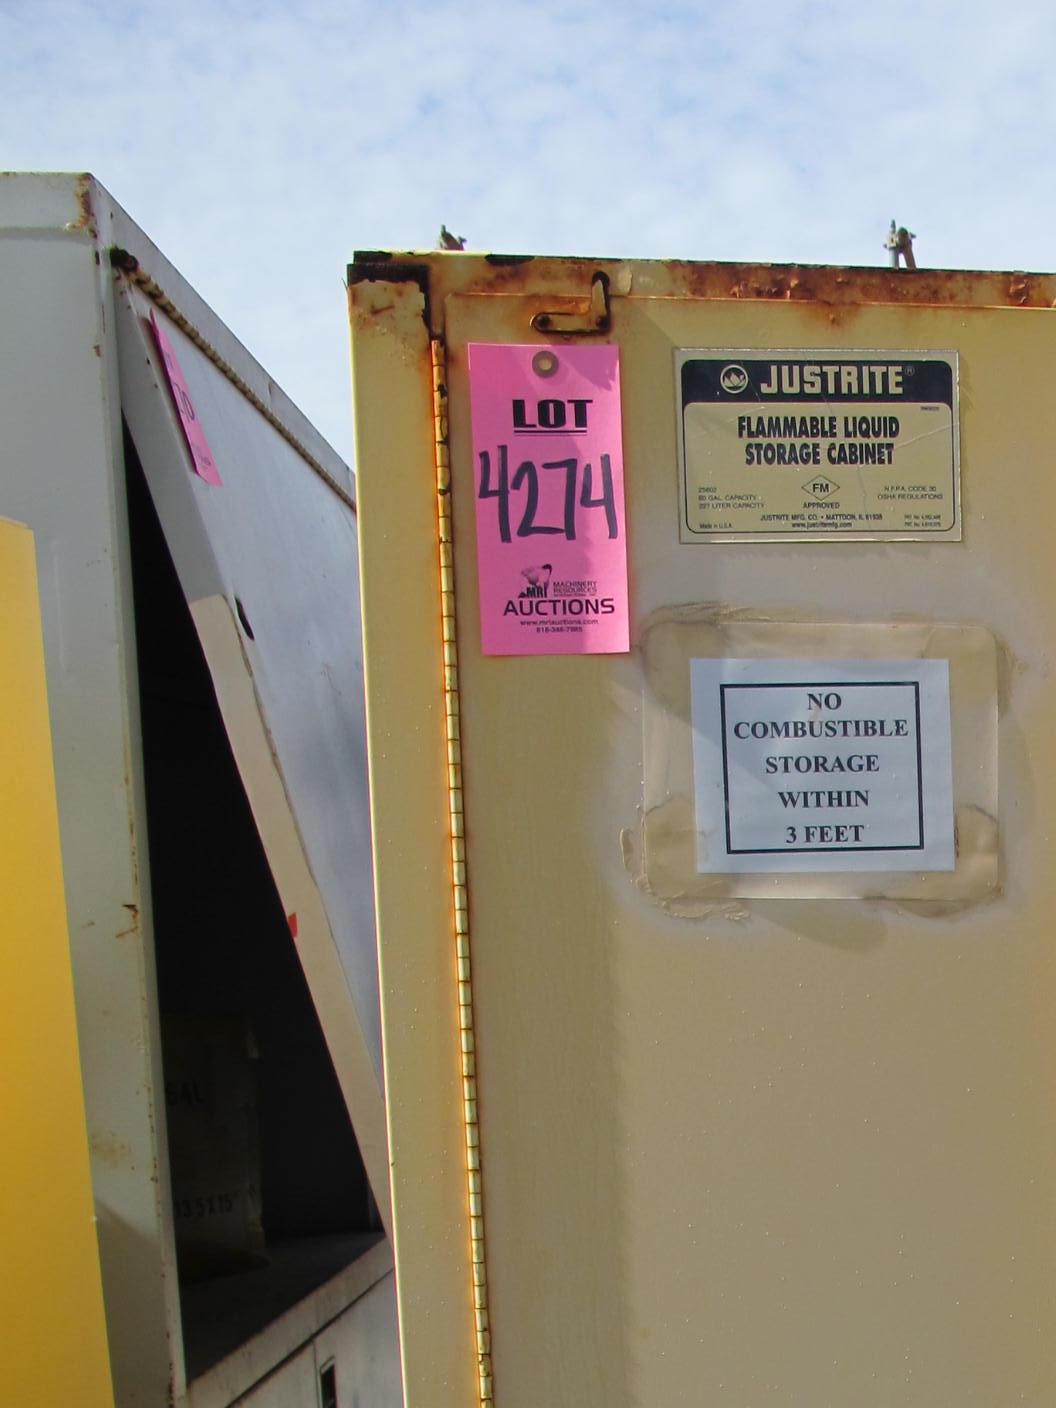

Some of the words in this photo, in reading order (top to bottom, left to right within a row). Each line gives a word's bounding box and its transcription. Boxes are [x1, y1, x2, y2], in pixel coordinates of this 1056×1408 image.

[760, 365, 904, 395] JUSTRITE
[512, 399, 593, 429] LOT
[738, 415, 837, 439] FLAMMABLE
[843, 415, 900, 440] LIQUID
[745, 442, 821, 465] STORAGE
[827, 442, 894, 465] CABINET
[478, 445, 618, 543] 4274
[812, 483, 829, 493] FM
[526, 583, 548, 598] MRI
[503, 598, 615, 616] AUCTIONS
[807, 692, 842, 711] NO
[733, 719, 908, 740] COMBUSTIBLE
[765, 754, 880, 775] STORAGE
[778, 790, 870, 809] WITHIN
[786, 826, 797, 844] 3
[804, 825, 865, 844] FEET
